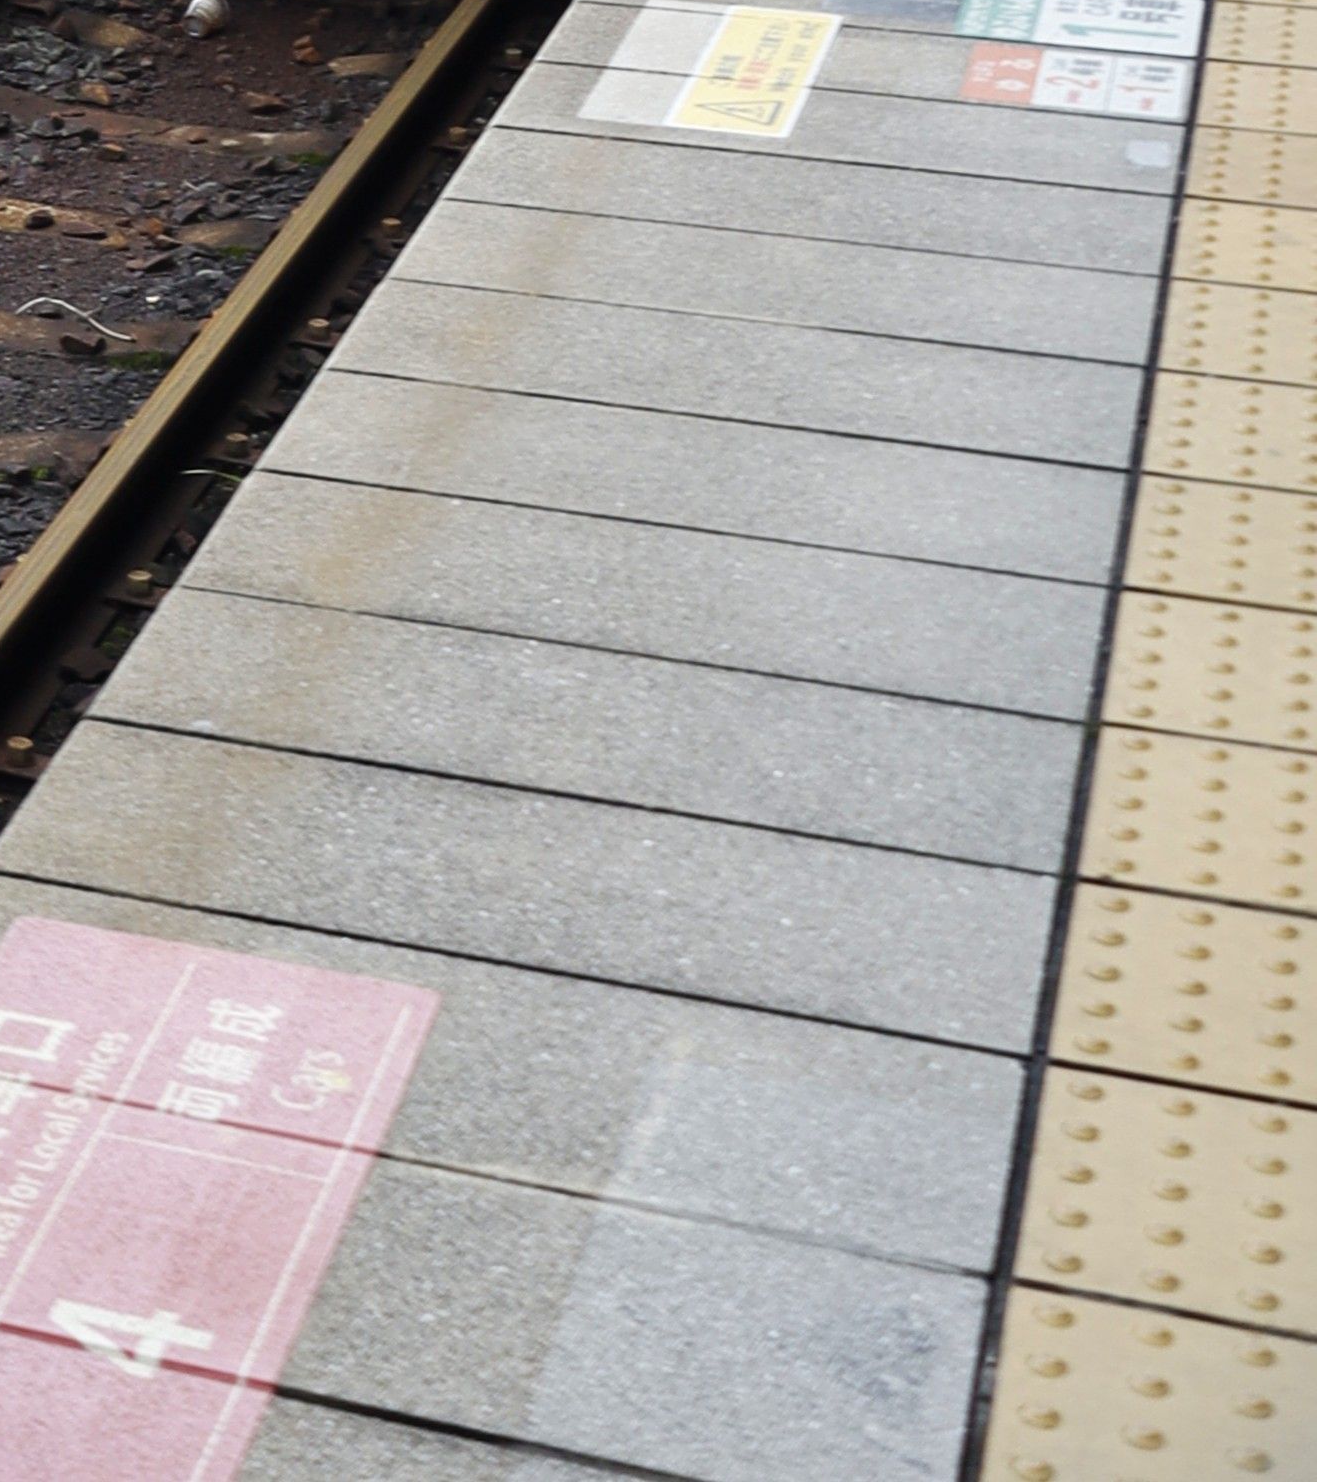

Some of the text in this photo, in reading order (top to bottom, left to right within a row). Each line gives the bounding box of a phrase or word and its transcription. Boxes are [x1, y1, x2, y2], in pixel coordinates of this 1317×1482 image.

[15, 1110, 82, 1173] Local
[53, 1031, 131, 1114] Services
[156, 998, 284, 1120] 両編成
[271, 1048, 345, 1111] Cars
[48, 1296, 217, 1379] 4
